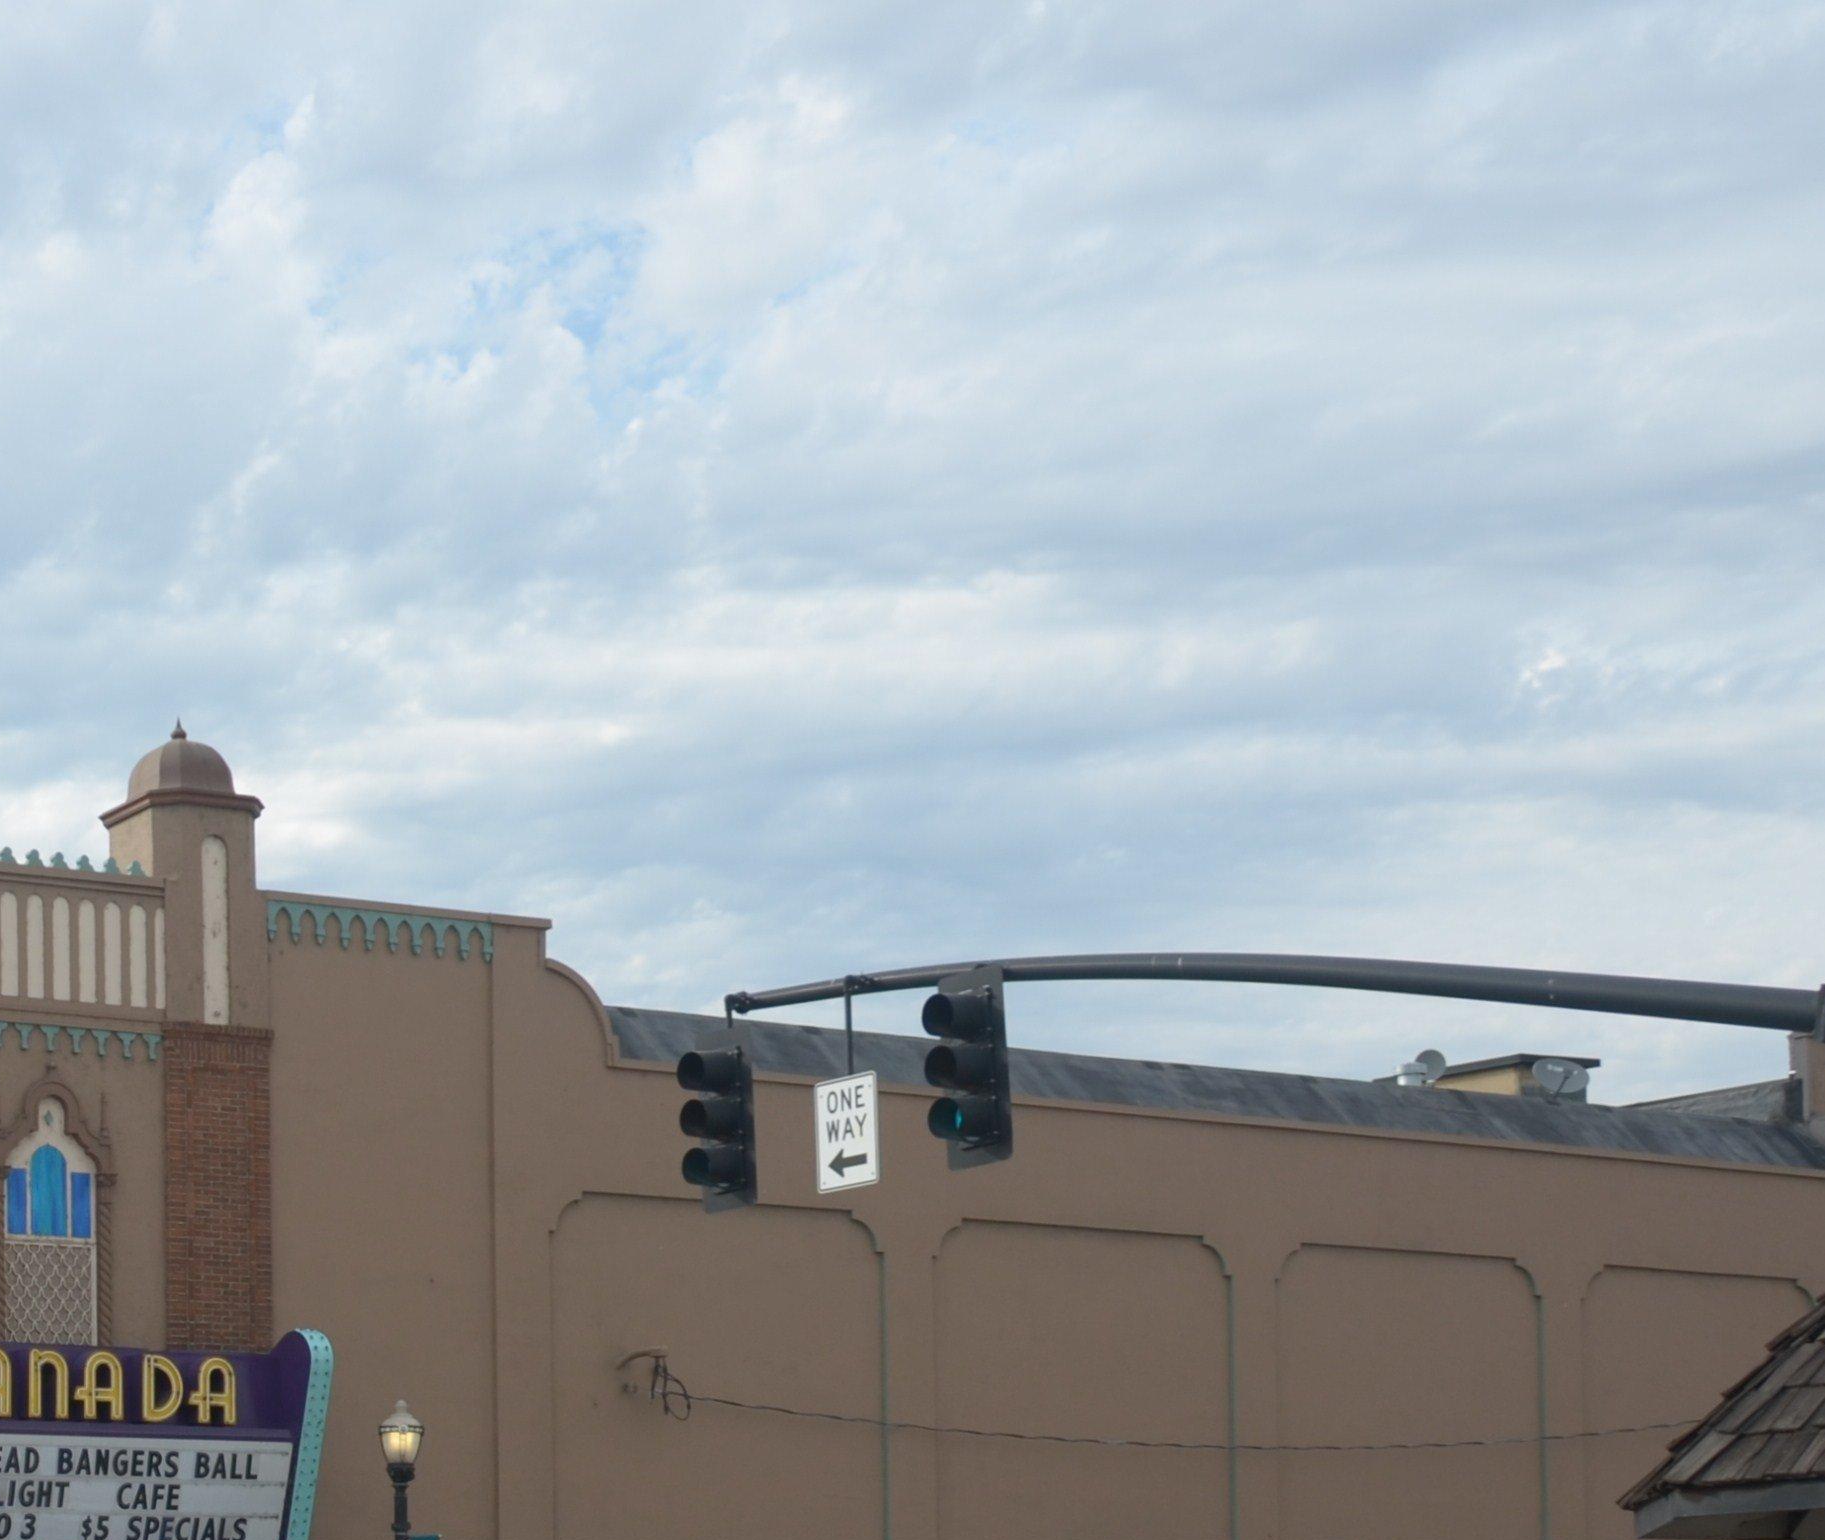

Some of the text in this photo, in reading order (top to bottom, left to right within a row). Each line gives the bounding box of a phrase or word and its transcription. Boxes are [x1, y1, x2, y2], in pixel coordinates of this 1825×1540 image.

[827, 1086, 865, 1113] ONE
[826, 1115, 867, 1143] WAY
[57, 1449, 179, 1478] BANGERS
[194, 1452, 259, 1480] BALL
[117, 1483, 180, 1511] CAFE
[19, 1513, 37, 1540] 3
